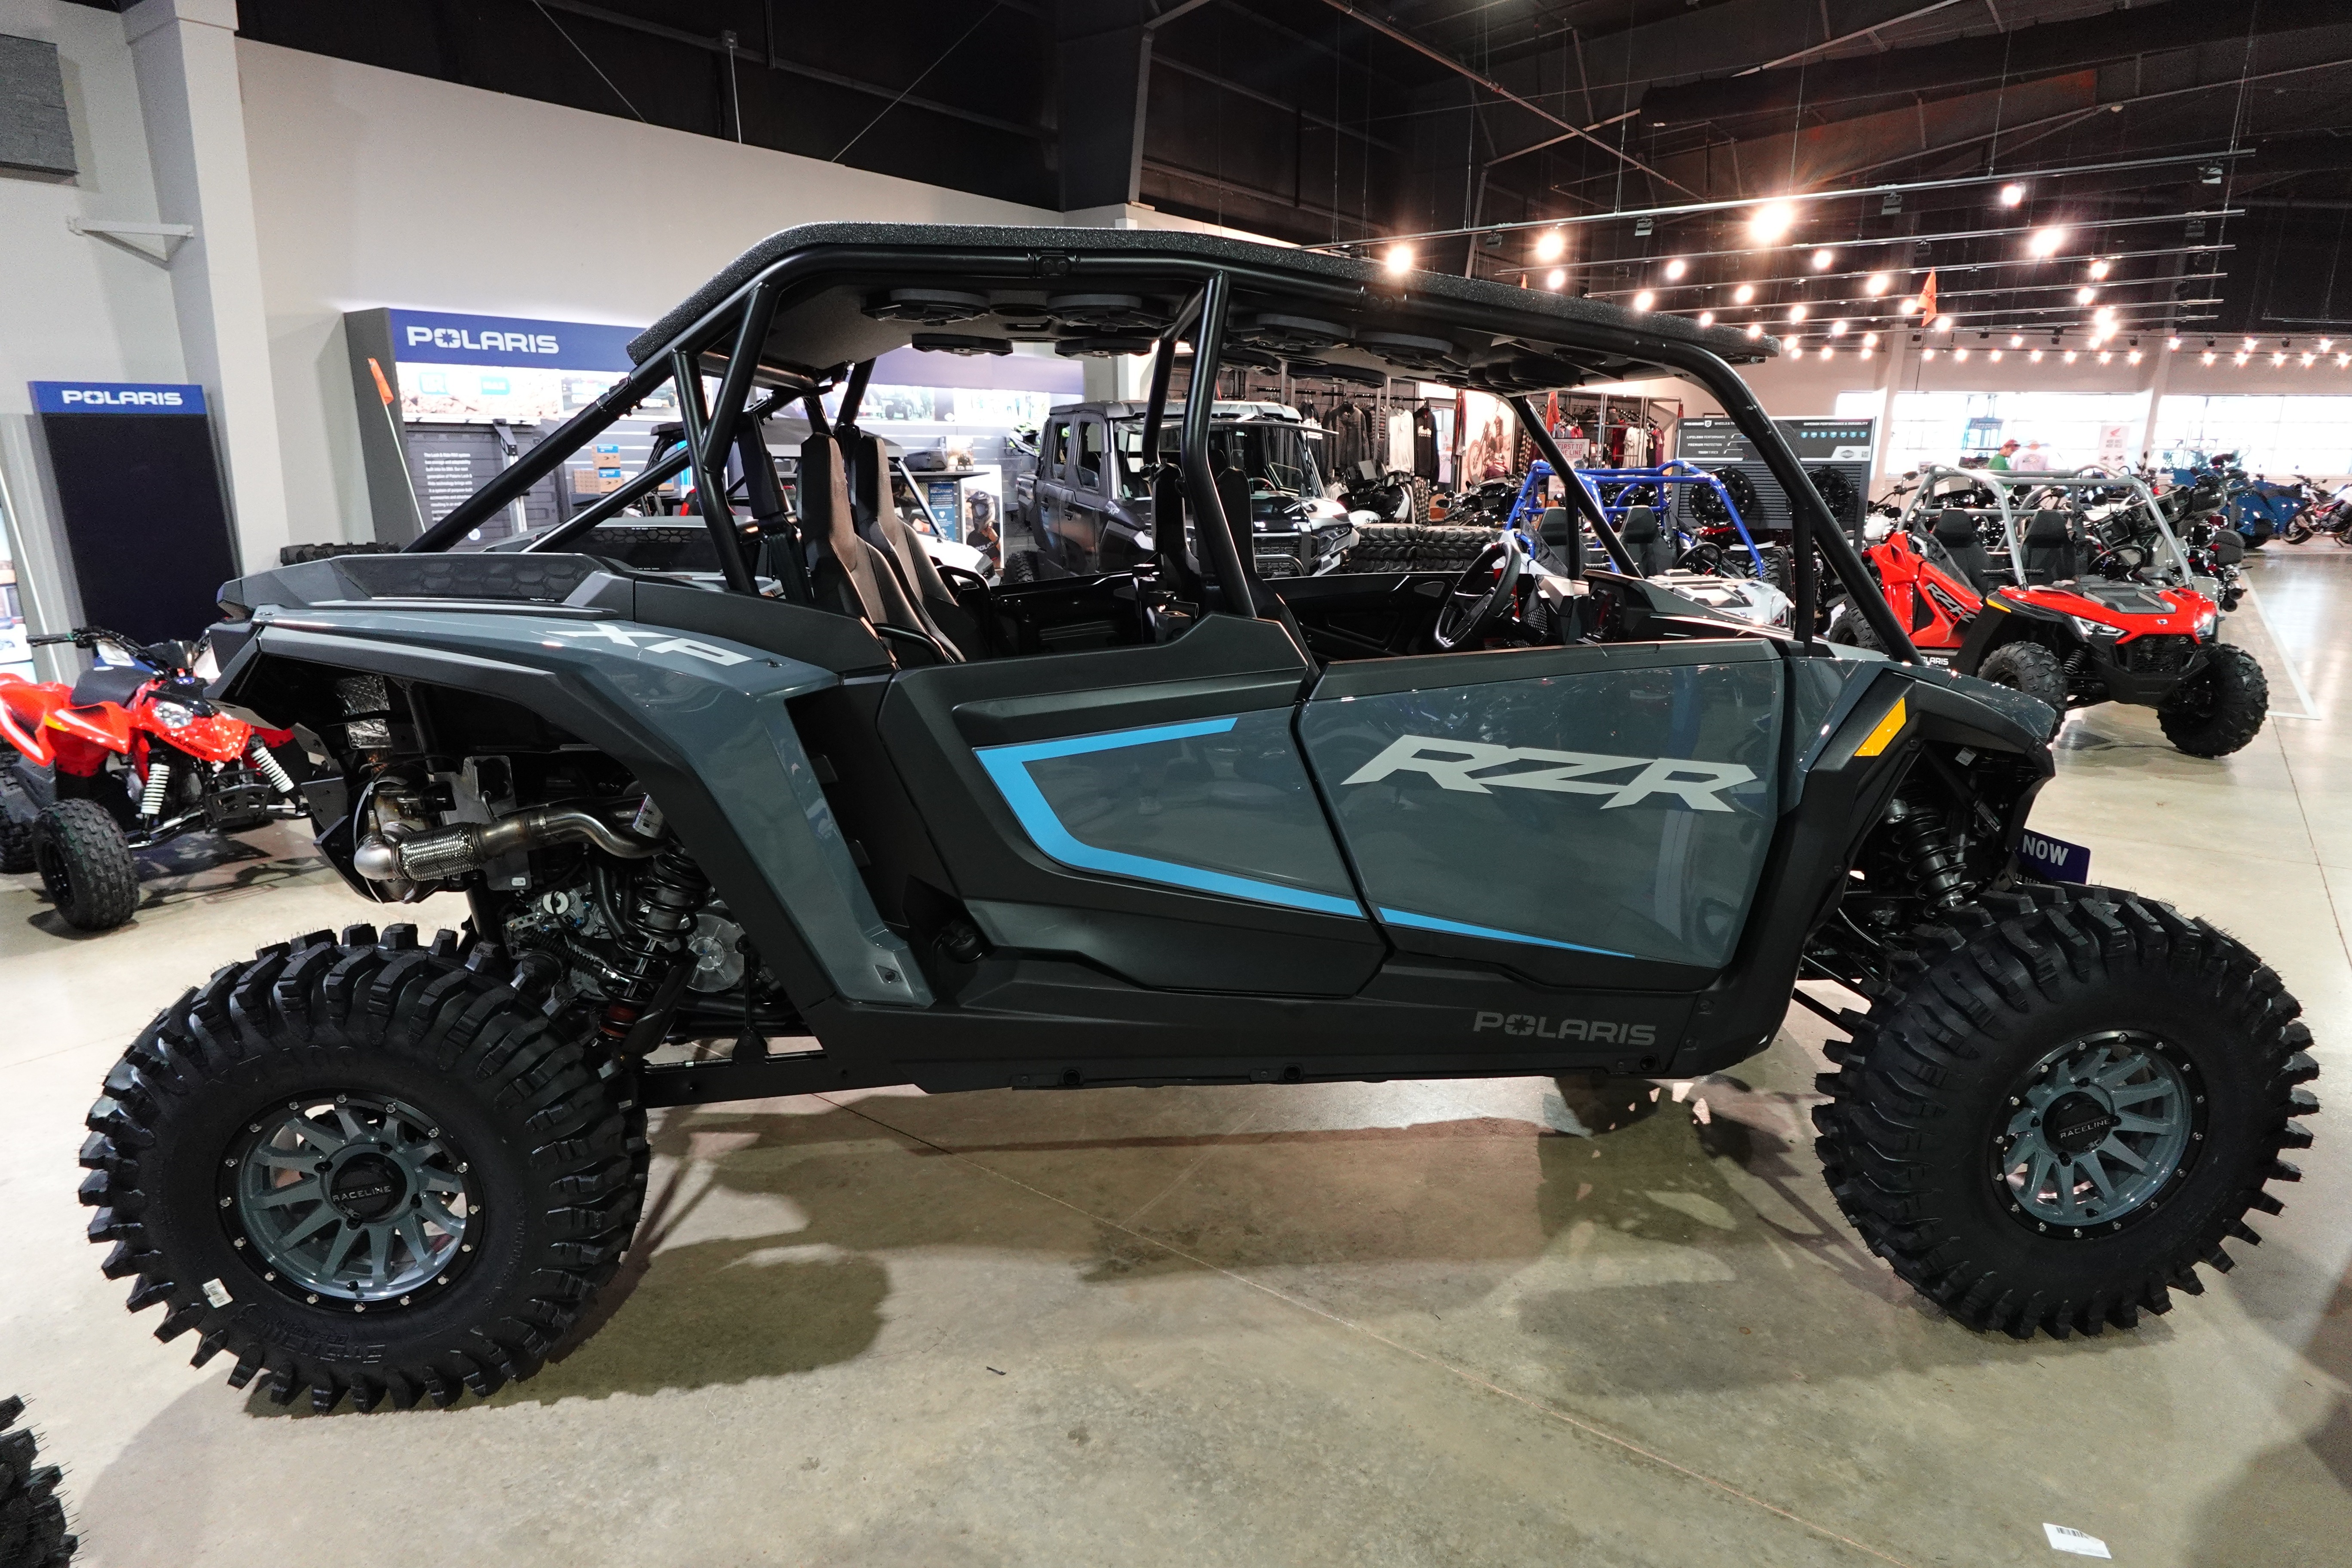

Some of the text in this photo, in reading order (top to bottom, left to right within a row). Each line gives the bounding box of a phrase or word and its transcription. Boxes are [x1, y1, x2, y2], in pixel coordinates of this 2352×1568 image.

[407, 325, 559, 354] POLARIS
[62, 389, 183, 406] POLARIS
[1105, 505, 1120, 515] XP
[1924, 582, 1977, 624] RZR
[546, 622, 753, 666] XP
[164, 731, 209, 757] POLARIS
[1340, 734, 1757, 812] RZR
[2022, 834, 2069, 867] NOW
[1473, 1011, 1657, 1046] POLARIS
[2059, 1118, 2112, 1139] RACELINE
[331, 1185, 392, 1202] RACELINE
